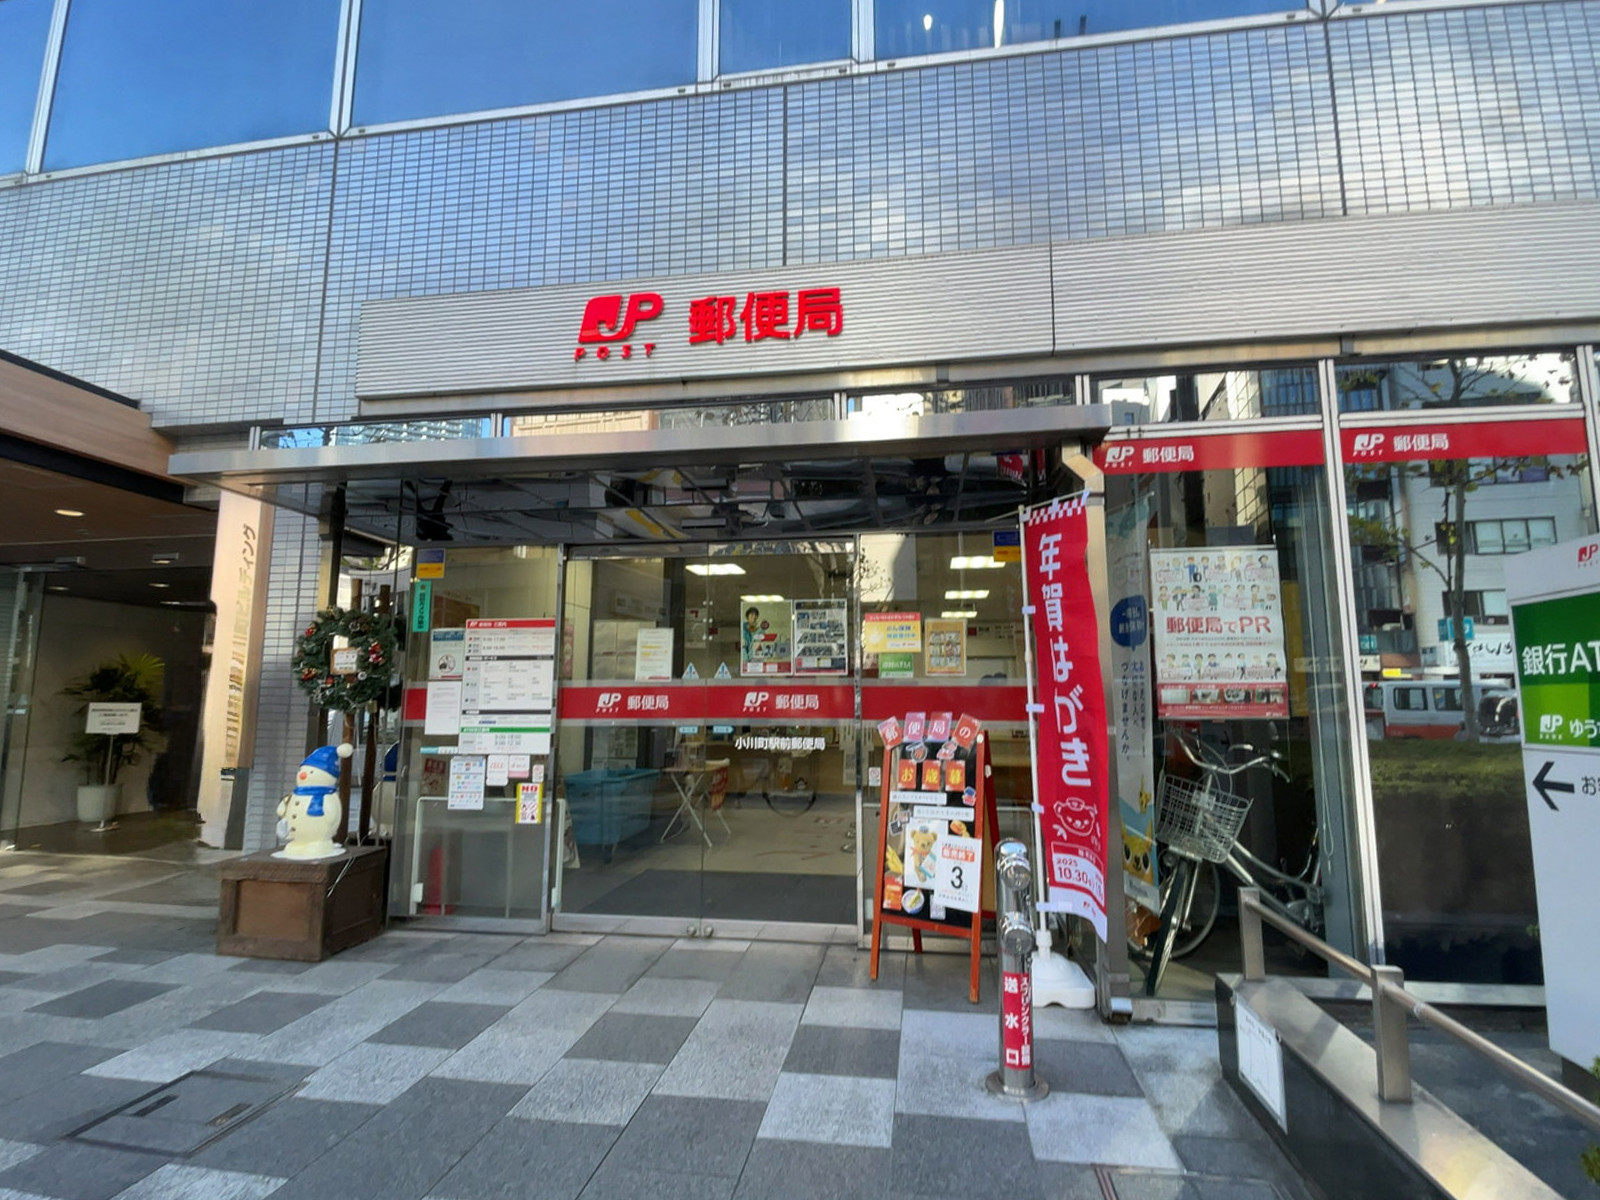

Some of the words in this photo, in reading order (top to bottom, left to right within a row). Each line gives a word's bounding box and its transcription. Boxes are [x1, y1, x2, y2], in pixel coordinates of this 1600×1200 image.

[578, 292, 664, 343] JP
[689, 287, 843, 345] 郵便局
[574, 343, 656, 361] POST
[1353, 433, 1385, 450] JP
[1393, 433, 1449, 452] 郵便局
[1105, 446, 1135, 463] JP
[1143, 445, 1194, 463] 郵便局
[1166, 616, 1272, 634] 郵便局でPR
[597, 692, 622, 708] JP
[627, 695, 669, 711] 郵便局
[744, 692, 770, 707] JP
[775, 694, 819, 710] 郵便局
[1540, 714, 1563, 733] JP
[735, 736, 826, 750] 小川町駅前郵便局
[1056, 858, 1078, 867] 2025
[950, 866, 963, 889] 3
[1003, 976, 1020, 1066] 送水口
